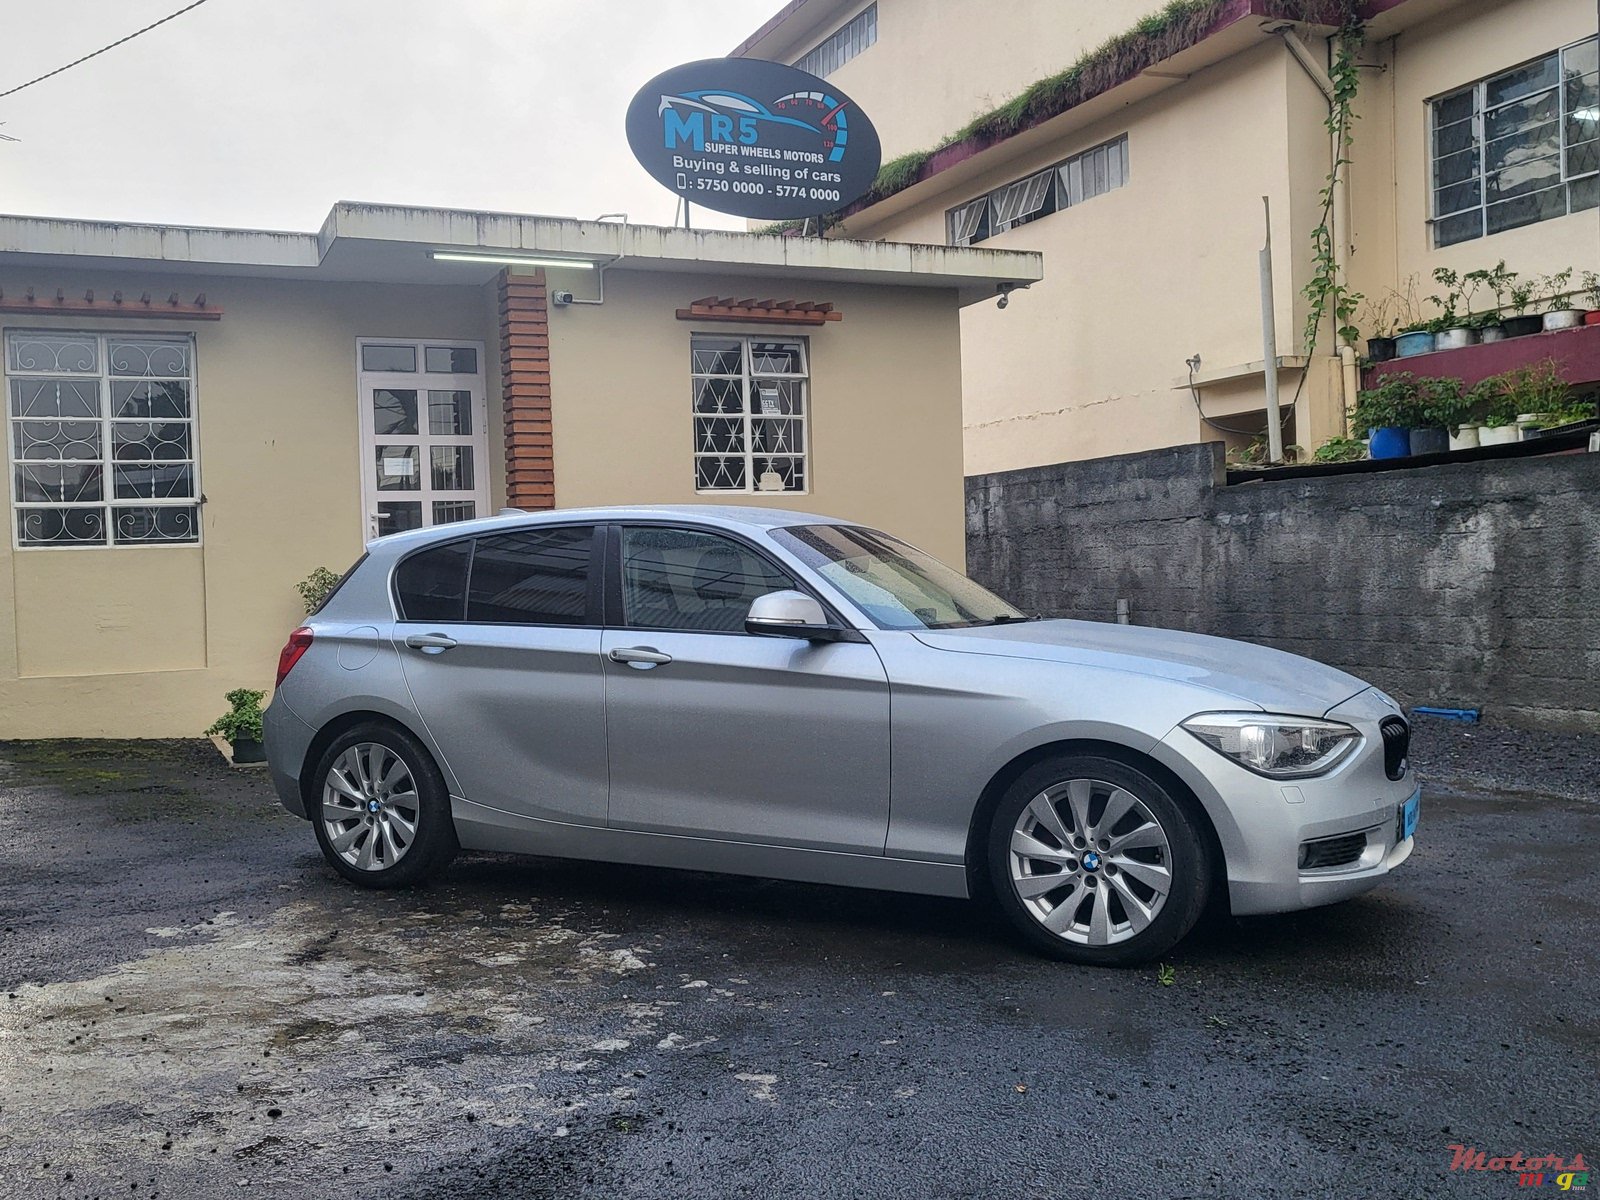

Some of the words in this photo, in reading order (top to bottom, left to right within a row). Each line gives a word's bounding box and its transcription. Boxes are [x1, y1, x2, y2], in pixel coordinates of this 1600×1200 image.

[664, 109, 758, 151] MR5
[705, 142, 738, 155] SUPER
[741, 146, 781, 159] WHEELS
[784, 150, 824, 163] MOTORS
[673, 155, 725, 174] Buying
[729, 161, 740, 173] &
[744, 164, 791, 180] selling
[795, 167, 809, 179] of
[812, 172, 841, 183] cars
[697, 178, 729, 191] 5750
[732, 181, 764, 195] 0000
[776, 186, 806, 198] 5774
[810, 188, 840, 201] 0000
